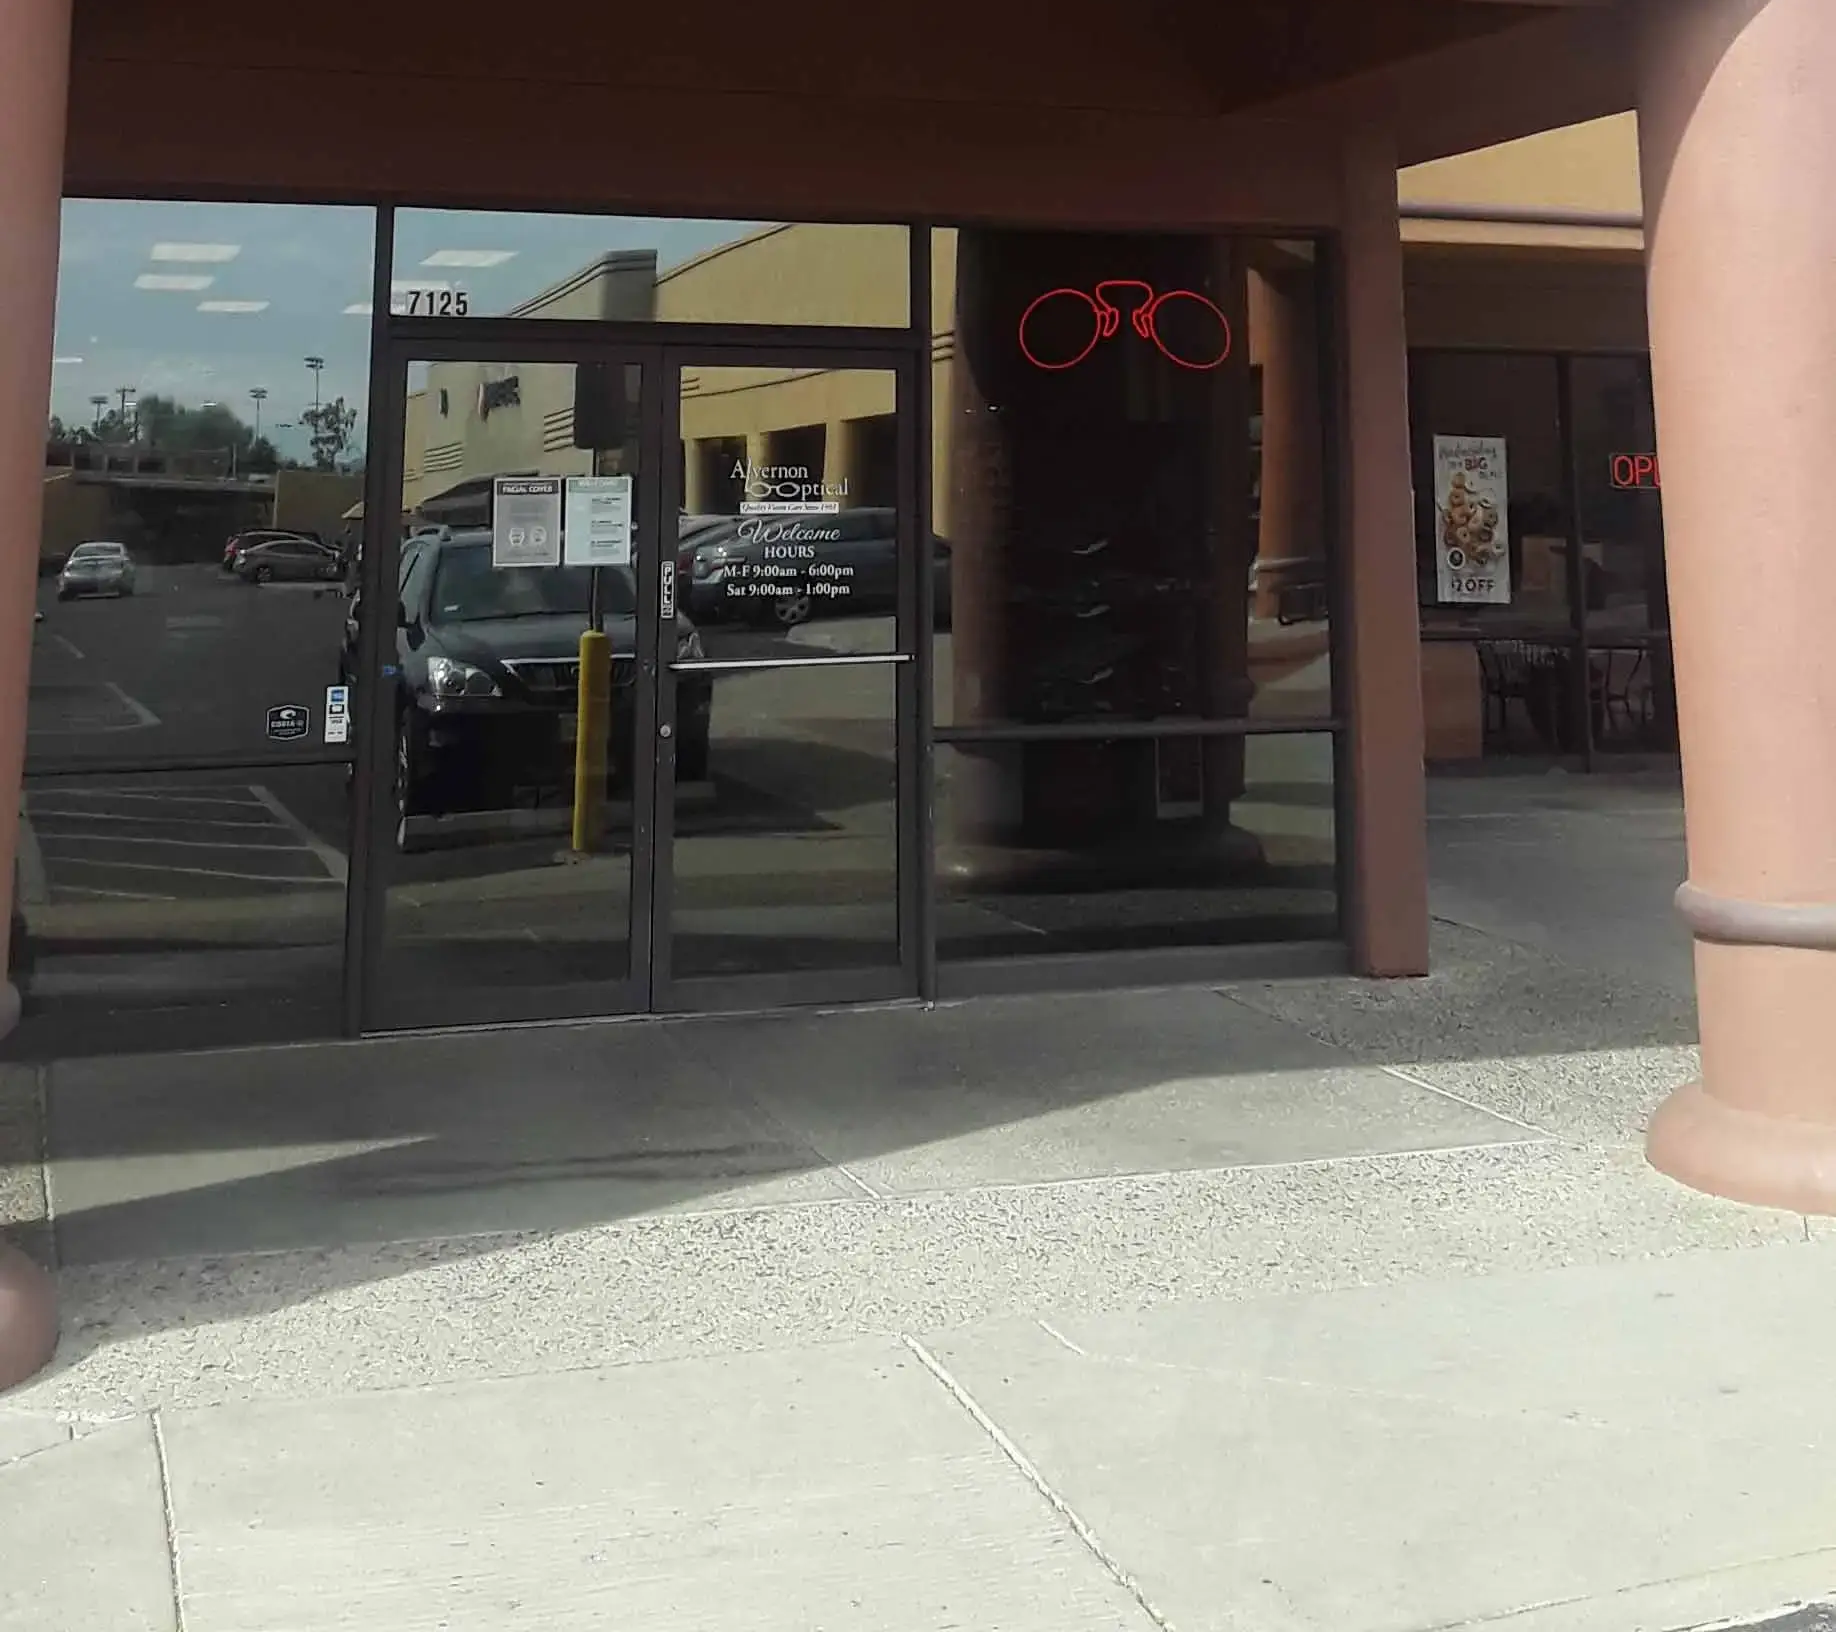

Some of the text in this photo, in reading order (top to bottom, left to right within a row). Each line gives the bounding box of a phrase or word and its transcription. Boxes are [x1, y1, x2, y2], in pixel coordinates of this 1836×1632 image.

[408, 291, 468, 316] 7125
[730, 455, 808, 481] Alvernon
[738, 519, 840, 543] Welcome
[764, 546, 815, 558] HOURS
[724, 565, 750, 577] M-F
[752, 565, 797, 577] 9:00am
[808, 564, 854, 579] 6:00pm
[727, 583, 746, 596] Sat
[749, 583, 793, 596] 9:00am
[806, 582, 850, 598] 1:00pm
[1465, 578, 1495, 593] OFF
